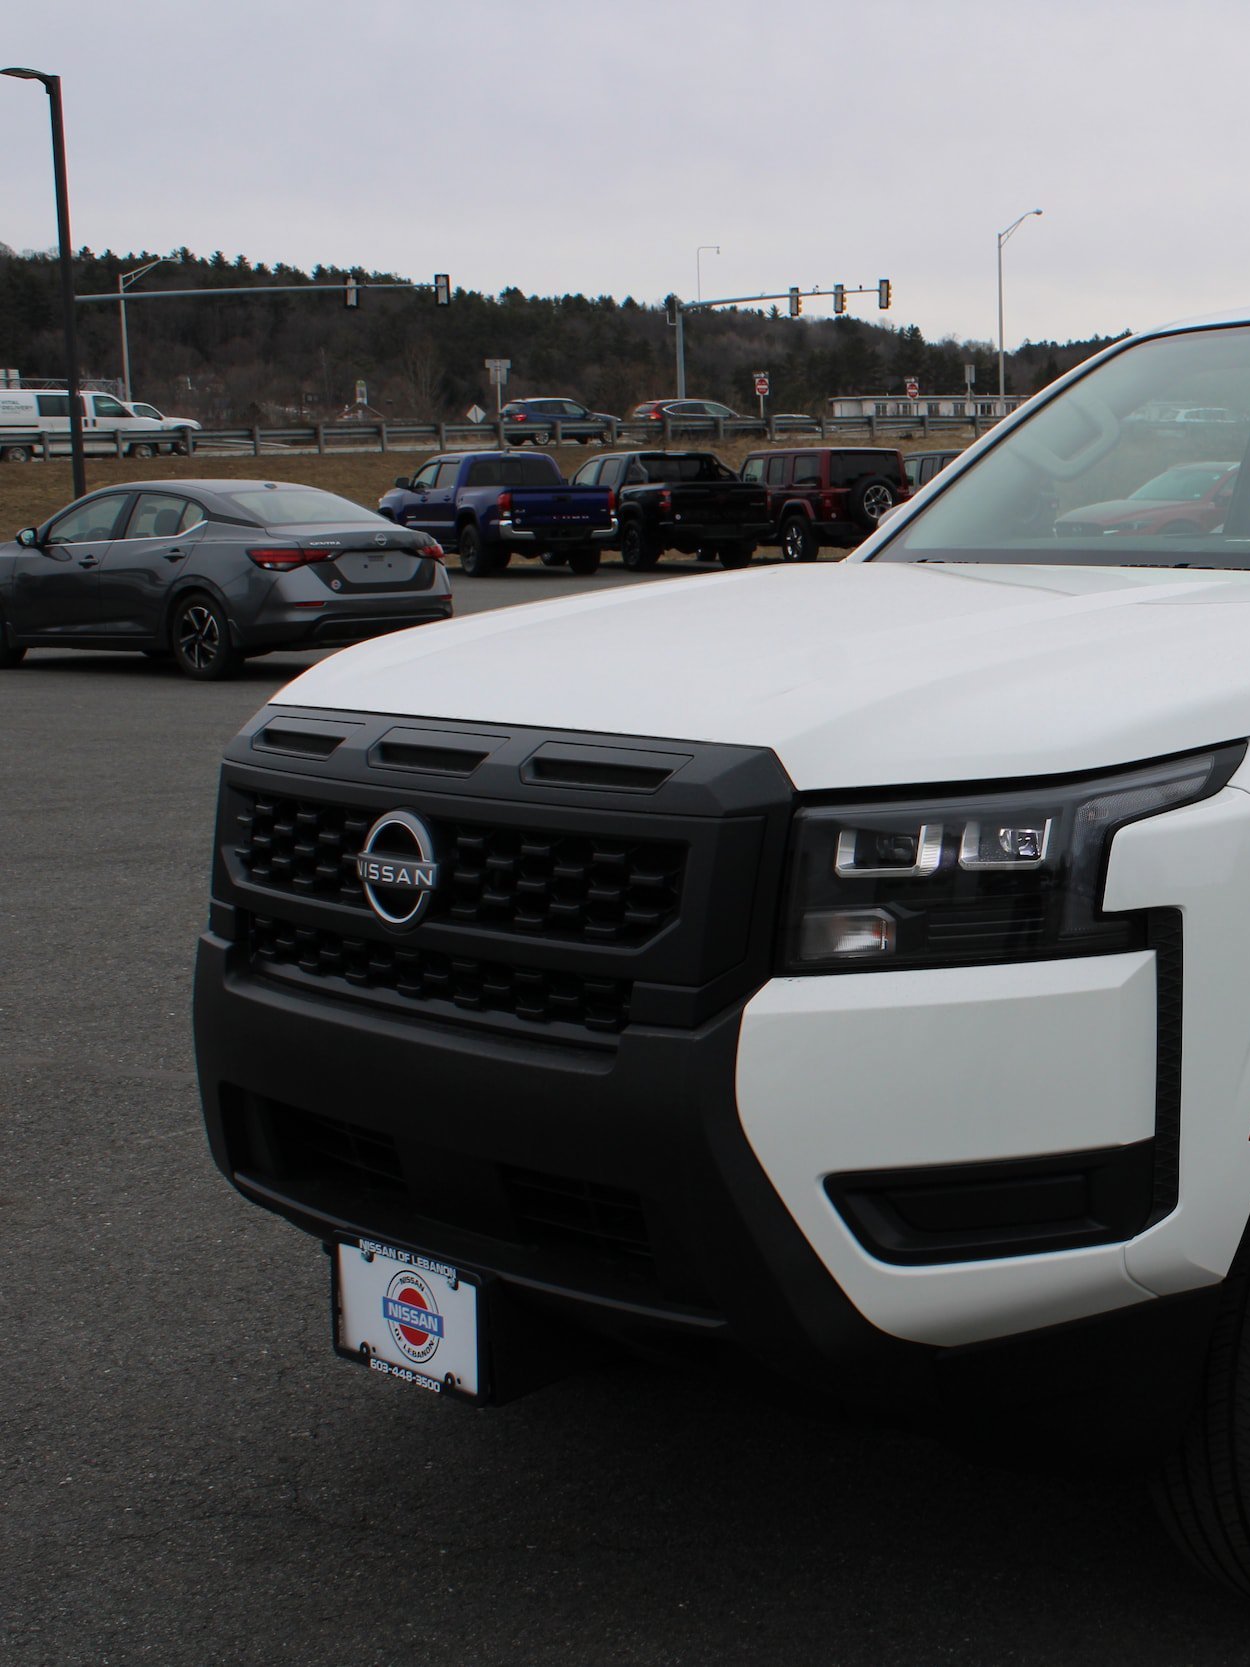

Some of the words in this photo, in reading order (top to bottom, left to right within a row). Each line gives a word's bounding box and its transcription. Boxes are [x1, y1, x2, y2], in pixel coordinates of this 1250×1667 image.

[357, 859, 433, 886] NISSAN
[359, 1239, 397, 1260] NISSAN
[398, 1250, 410, 1264] OF
[411, 1254, 457, 1279] LEBANON
[399, 1276, 426, 1292] NISSAN
[388, 1302, 439, 1332] NISSAN
[394, 1328, 403, 1342] OF
[403, 1340, 436, 1359] LEBANON
[370, 1358, 441, 1393] 603-448-3500
